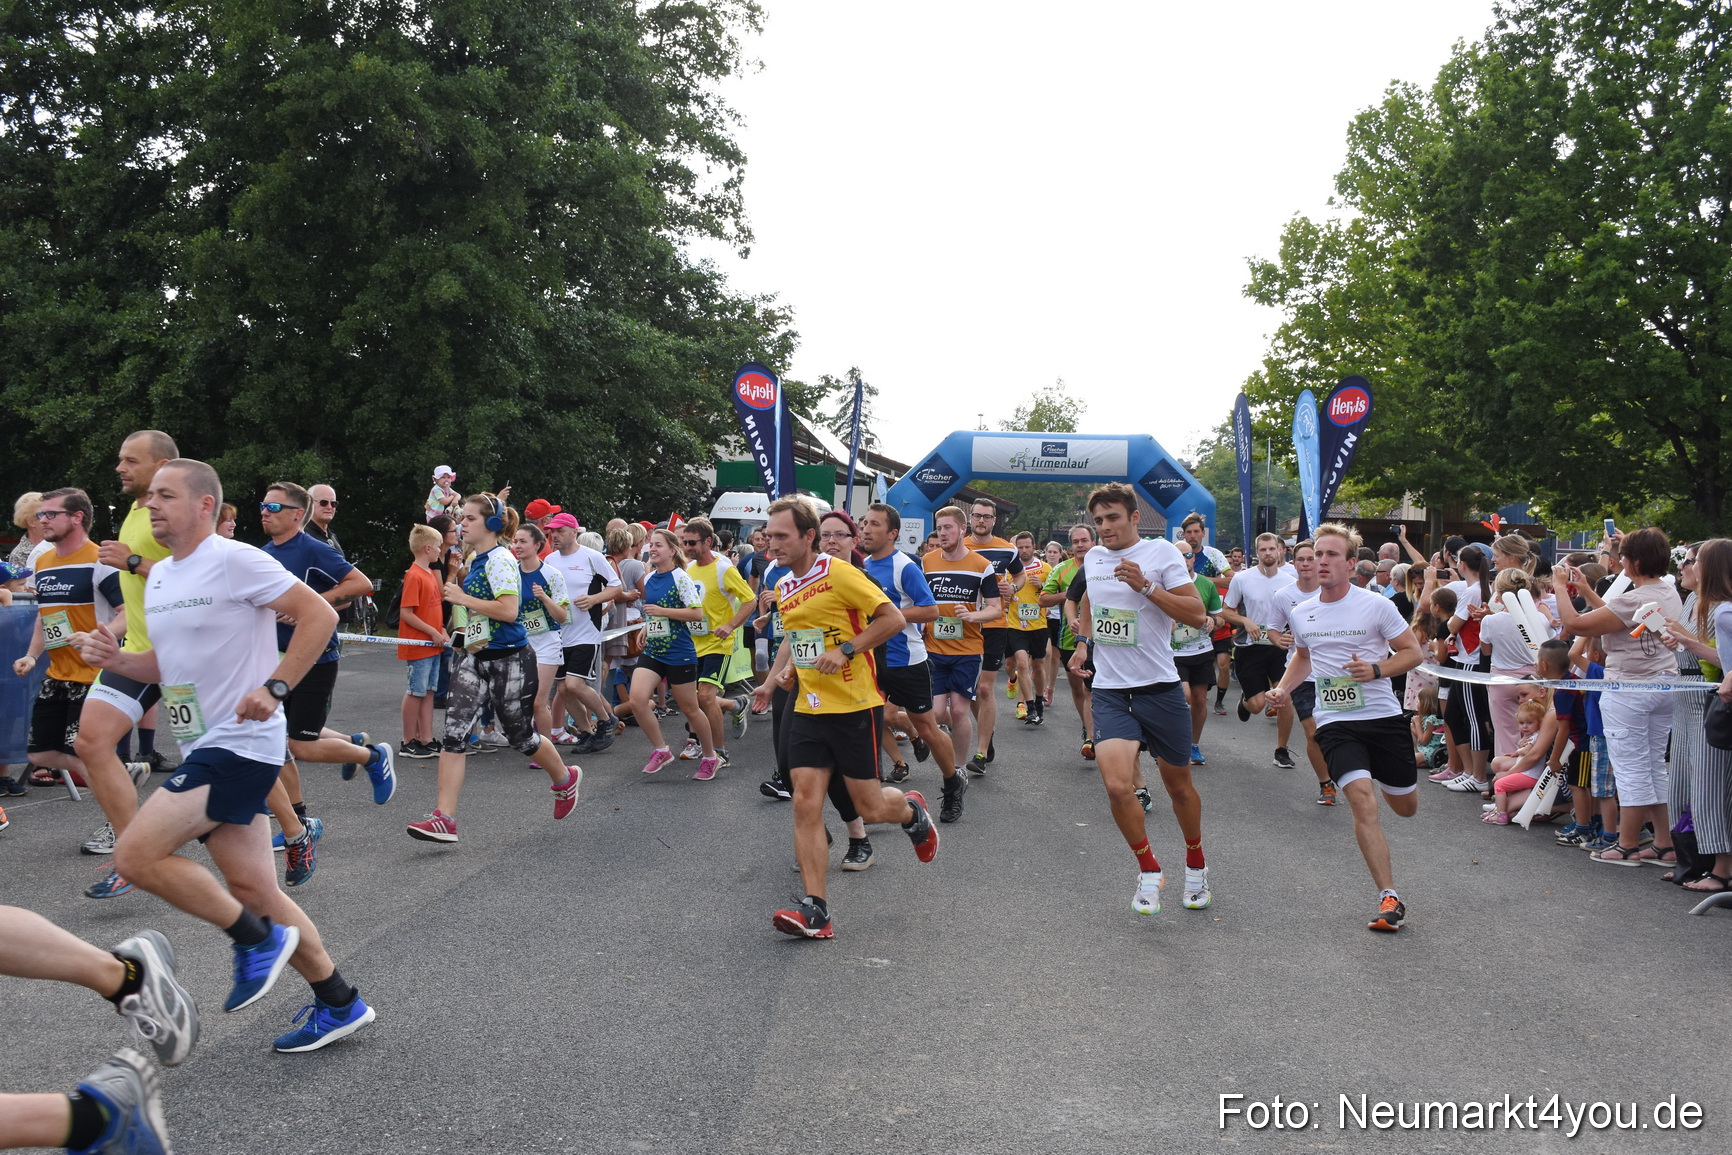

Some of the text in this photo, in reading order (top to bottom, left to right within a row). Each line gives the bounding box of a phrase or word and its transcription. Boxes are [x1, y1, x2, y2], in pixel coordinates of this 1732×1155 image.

[1331, 396, 1366, 417] Hervis
[1031, 456, 1089, 469] firmenlauf
[921, 473, 953, 481] Fischer
[38, 582, 75, 593] Fischer
[802, 581, 833, 601] BÖGL
[933, 584, 977, 596] Fischer
[1020, 608, 1038, 616] 1570
[467, 623, 482, 638] 236
[649, 621, 663, 632] 274
[938, 624, 956, 634] 749
[1096, 619, 1129, 637] 2091
[1335, 629, 1367, 638] HOLZBAU
[1516, 624, 1532, 643] swn
[792, 643, 818, 658] 1671
[1322, 687, 1357, 702] 2096
[1538, 769, 1554, 791] swn
